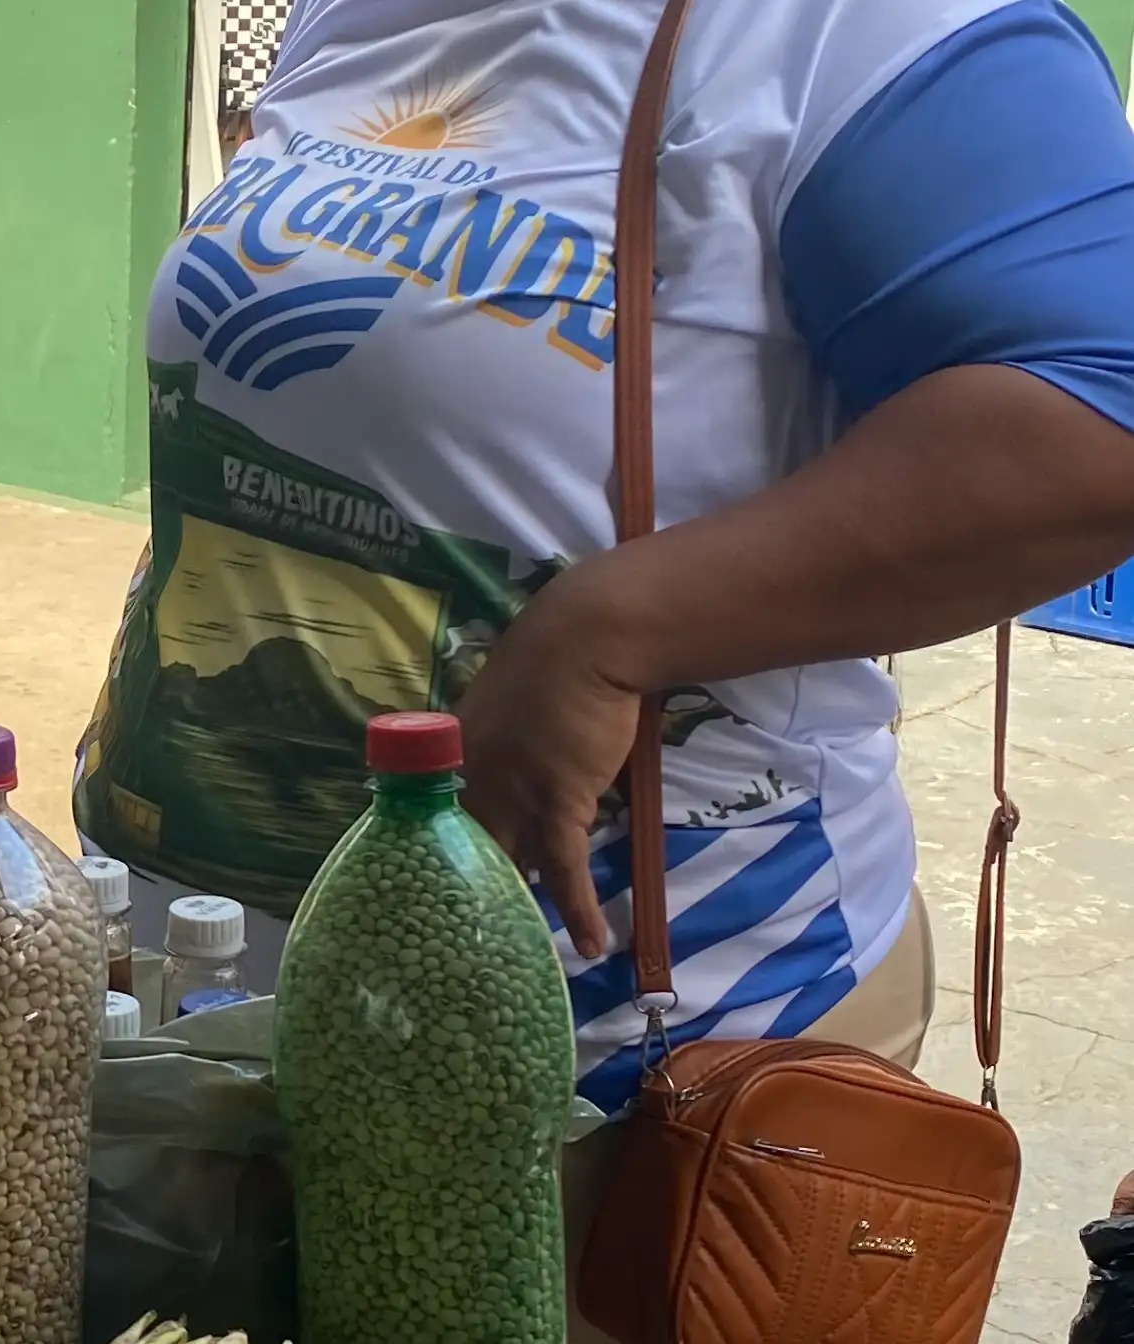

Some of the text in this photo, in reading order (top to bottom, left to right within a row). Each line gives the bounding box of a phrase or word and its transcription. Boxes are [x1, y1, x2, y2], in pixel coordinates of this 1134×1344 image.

[299, 140, 446, 180] FESTIVAL
[442, 160, 498, 186] DA
[223, 455, 421, 548] BENEDITINOS
